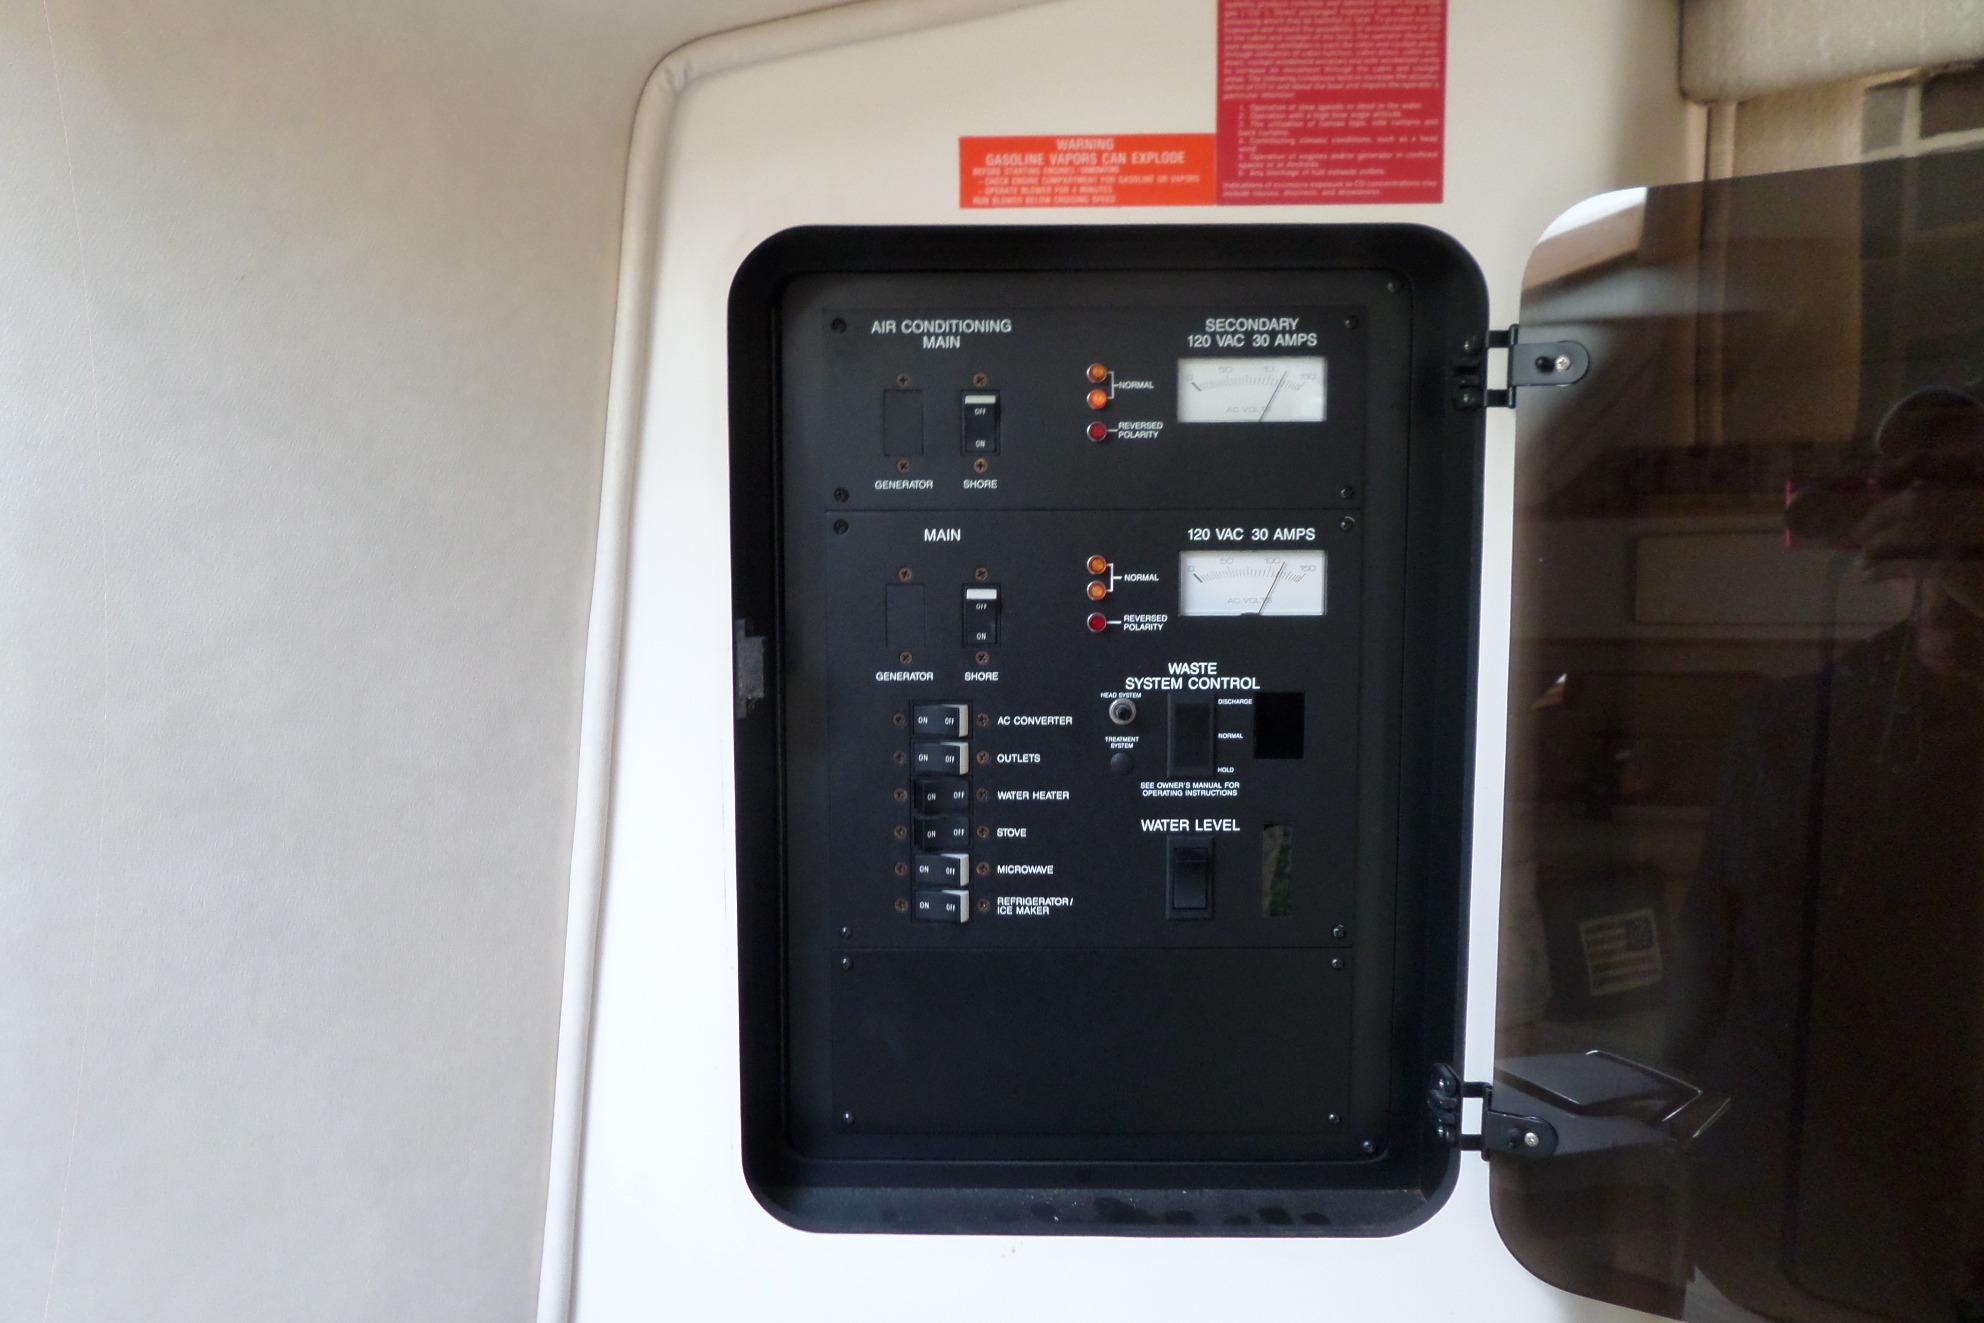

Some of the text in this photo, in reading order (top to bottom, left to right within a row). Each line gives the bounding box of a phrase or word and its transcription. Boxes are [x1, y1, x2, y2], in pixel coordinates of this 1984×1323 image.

[1056, 138, 1114, 150] WARNING
[985, 151, 1185, 166] GASOLINE VAPORS CAN EXPLODE
[871, 319, 1012, 334] AIR CONDITIONING
[1205, 318, 1300, 332] SECONDARY
[922, 336, 960, 349] MAIN
[1188, 333, 1318, 348] 120 VAC 30 AMPS
[1119, 381, 1154, 389] NORMAL
[974, 408, 986, 416] OFF
[1118, 422, 1164, 430] REVERSED
[1118, 430, 1159, 439] POLARITY
[975, 440, 986, 448] ON
[874, 480, 934, 490] GENERATOR
[963, 480, 998, 489] SHORE
[924, 528, 961, 542] MAIN
[1188, 528, 1316, 541] 120 VAC 30 AMPS
[1124, 574, 1159, 582] NORMAL
[1123, 614, 1168, 623] REVERSED
[1123, 623, 1164, 631] POLARITY
[976, 632, 987, 640] ON
[1168, 662, 1218, 675] WASTE
[876, 672, 934, 681] GENERATOR
[964, 672, 999, 681] SHORE
[1125, 677, 1260, 690] SYSTEM CONTROL
[918, 716, 928, 724] ON
[944, 717, 954, 725] OFF
[997, 716, 1072, 725] AC CONVERTER
[918, 754, 928, 762] ON
[945, 755, 955, 764] OFF
[996, 754, 1041, 763] OUTLETS
[927, 793, 936, 801] ON
[953, 791, 964, 799] OFF
[997, 790, 1070, 800] WATER HEATER
[1141, 819, 1240, 832] WATER LEVEL
[927, 830, 936, 839] ON
[953, 828, 964, 837] OFF
[996, 828, 1026, 838] STOVE
[919, 865, 929, 873] ON
[945, 867, 955, 876] OFF
[997, 865, 1054, 874] MICROWAVE
[919, 902, 930, 910] ON
[997, 897, 1074, 907] REFRIGERATOR/
[946, 903, 955, 912] OFF
[997, 906, 1050, 915] ICE MAKER
